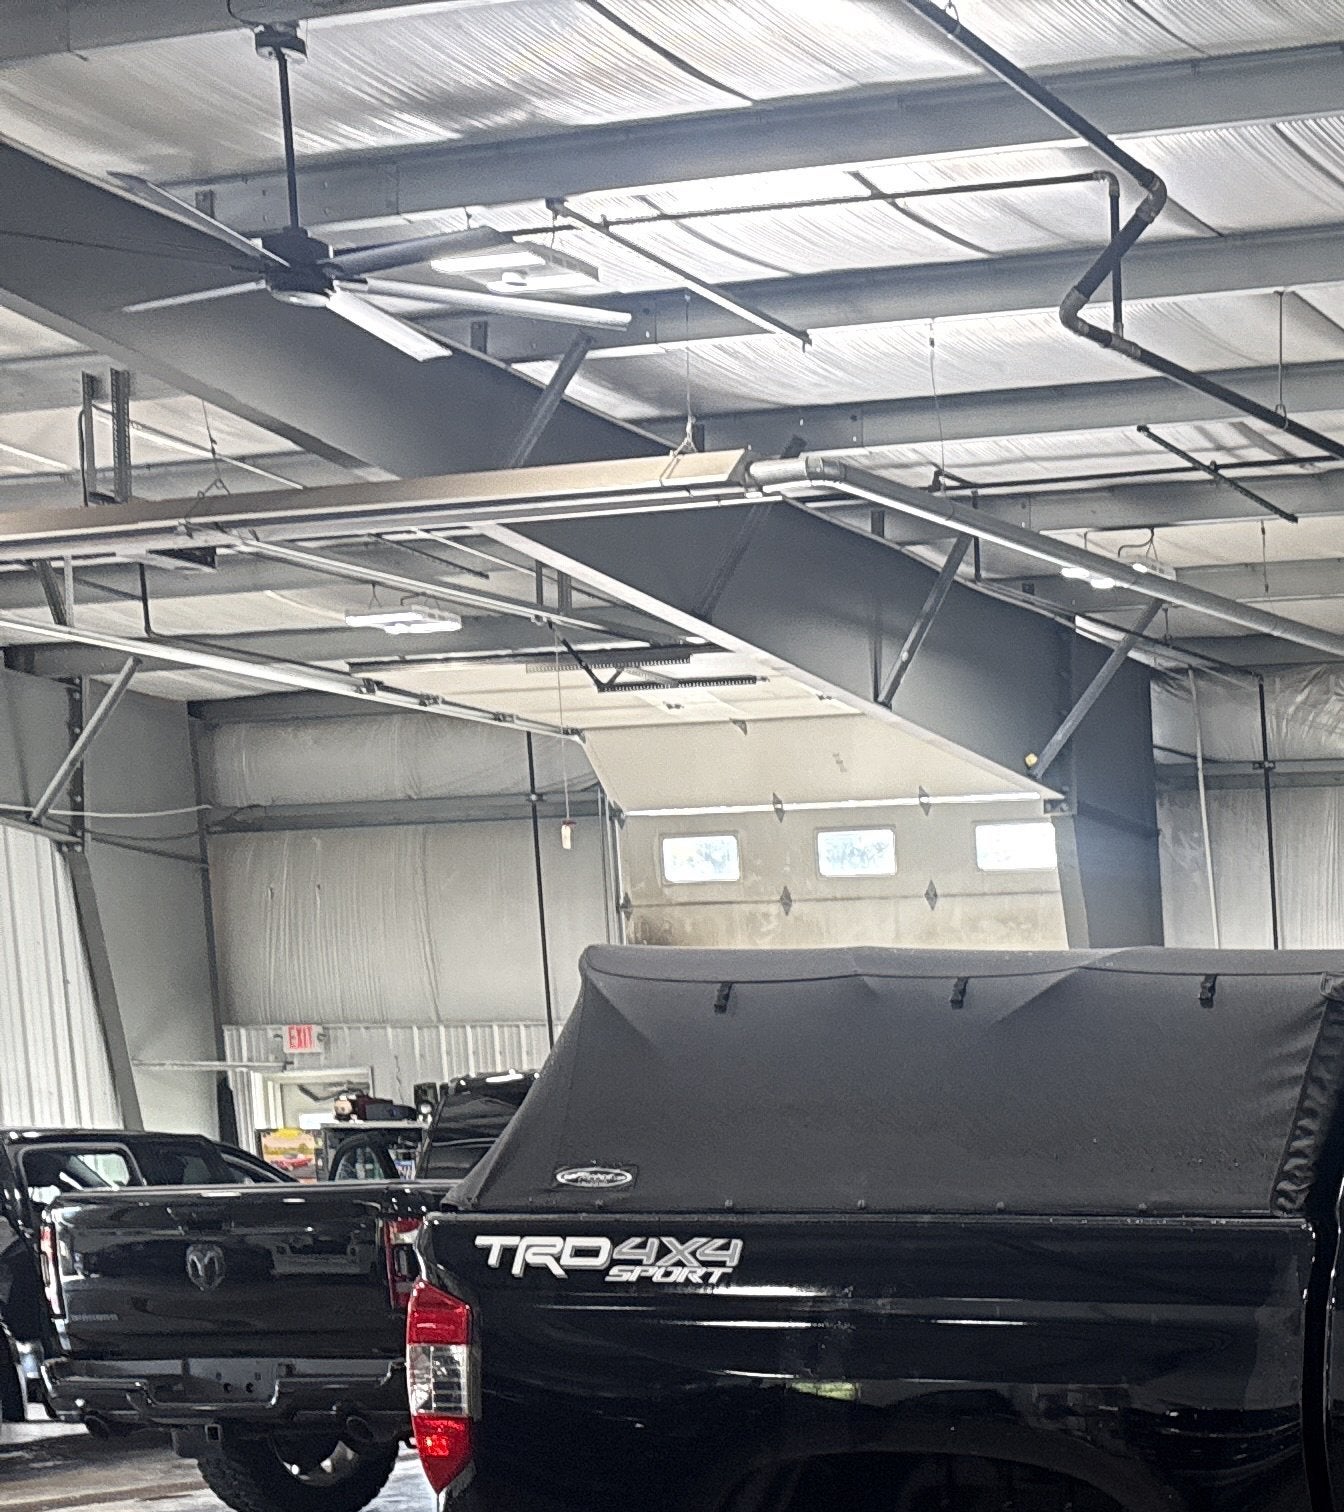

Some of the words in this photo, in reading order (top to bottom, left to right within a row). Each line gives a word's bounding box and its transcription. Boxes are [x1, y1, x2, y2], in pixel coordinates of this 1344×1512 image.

[288, 1024, 313, 1049] EXIT
[475, 1235, 613, 1279] TRD
[604, 1265, 734, 1283] SPORT
